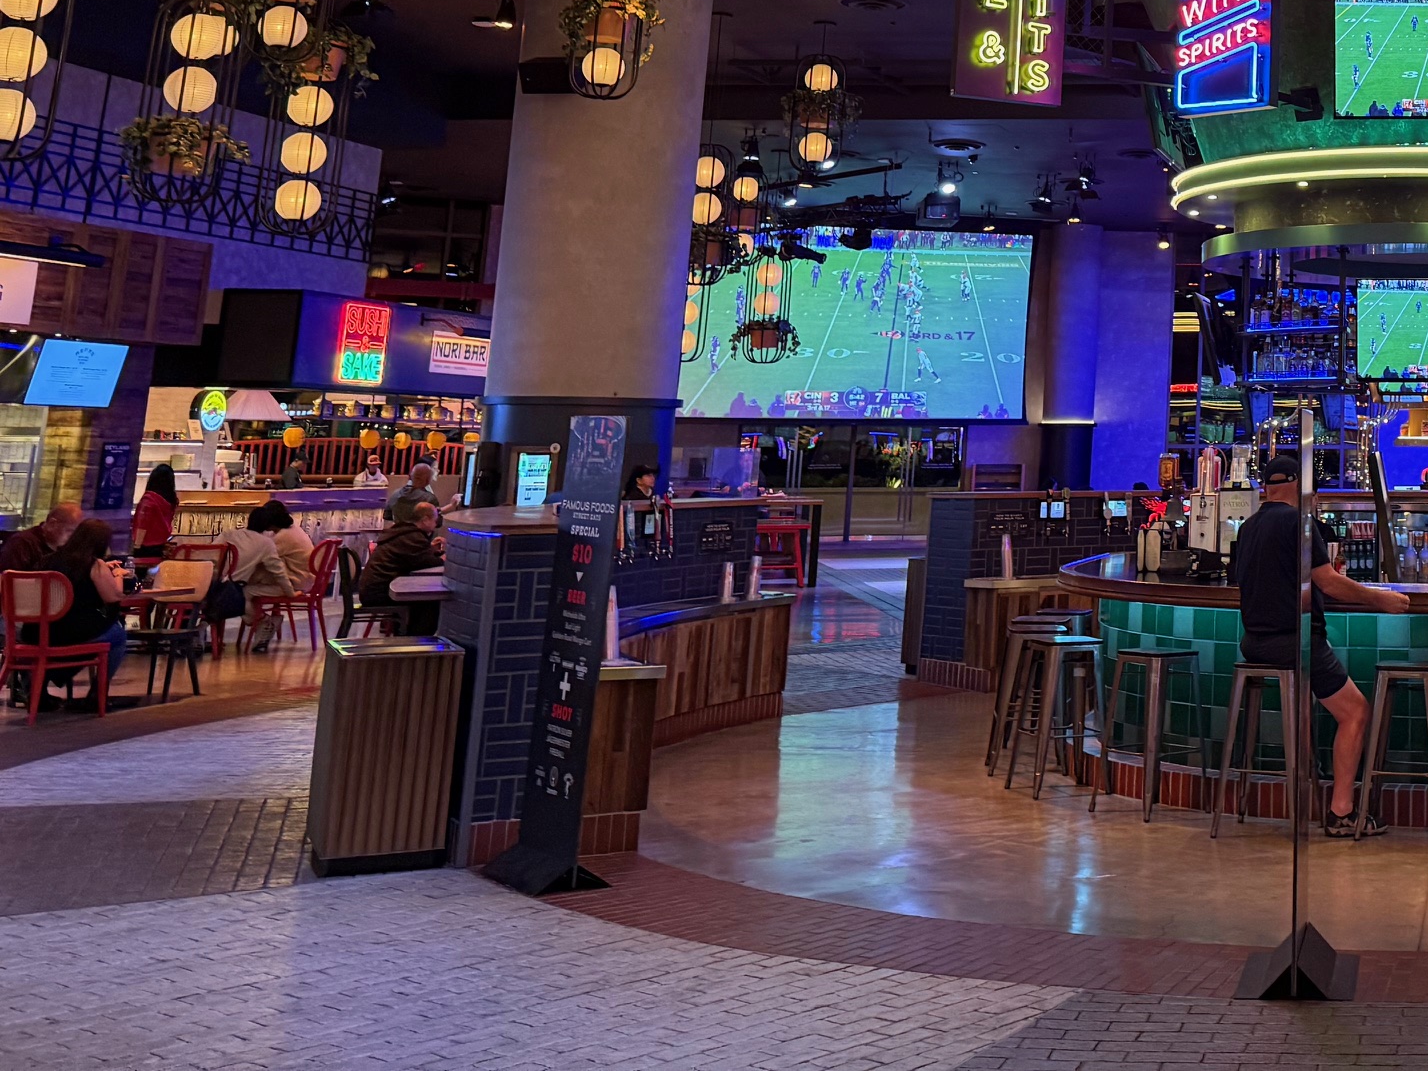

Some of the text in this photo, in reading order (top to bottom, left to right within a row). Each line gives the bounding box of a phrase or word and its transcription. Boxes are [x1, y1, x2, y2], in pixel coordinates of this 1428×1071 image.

[979, 30, 1006, 64] &
[1179, 18, 1259, 67] SPIRITS
[347, 307, 388, 337] SUSHI
[360, 335, 370, 353] &
[956, 331, 976, 340] 17
[434, 341, 487, 362] NORI BAR
[341, 351, 383, 382] SAKE
[804, 392, 822, 400] CIN
[829, 392, 839, 403] 3
[874, 392, 884, 403] 7
[891, 392, 911, 400] BAL
[562, 499, 615, 514] FAMOUS FOODS
[571, 524, 600, 538] SPECIAL
[572, 543, 593, 564] $10
[551, 703, 573, 722] SHOT
